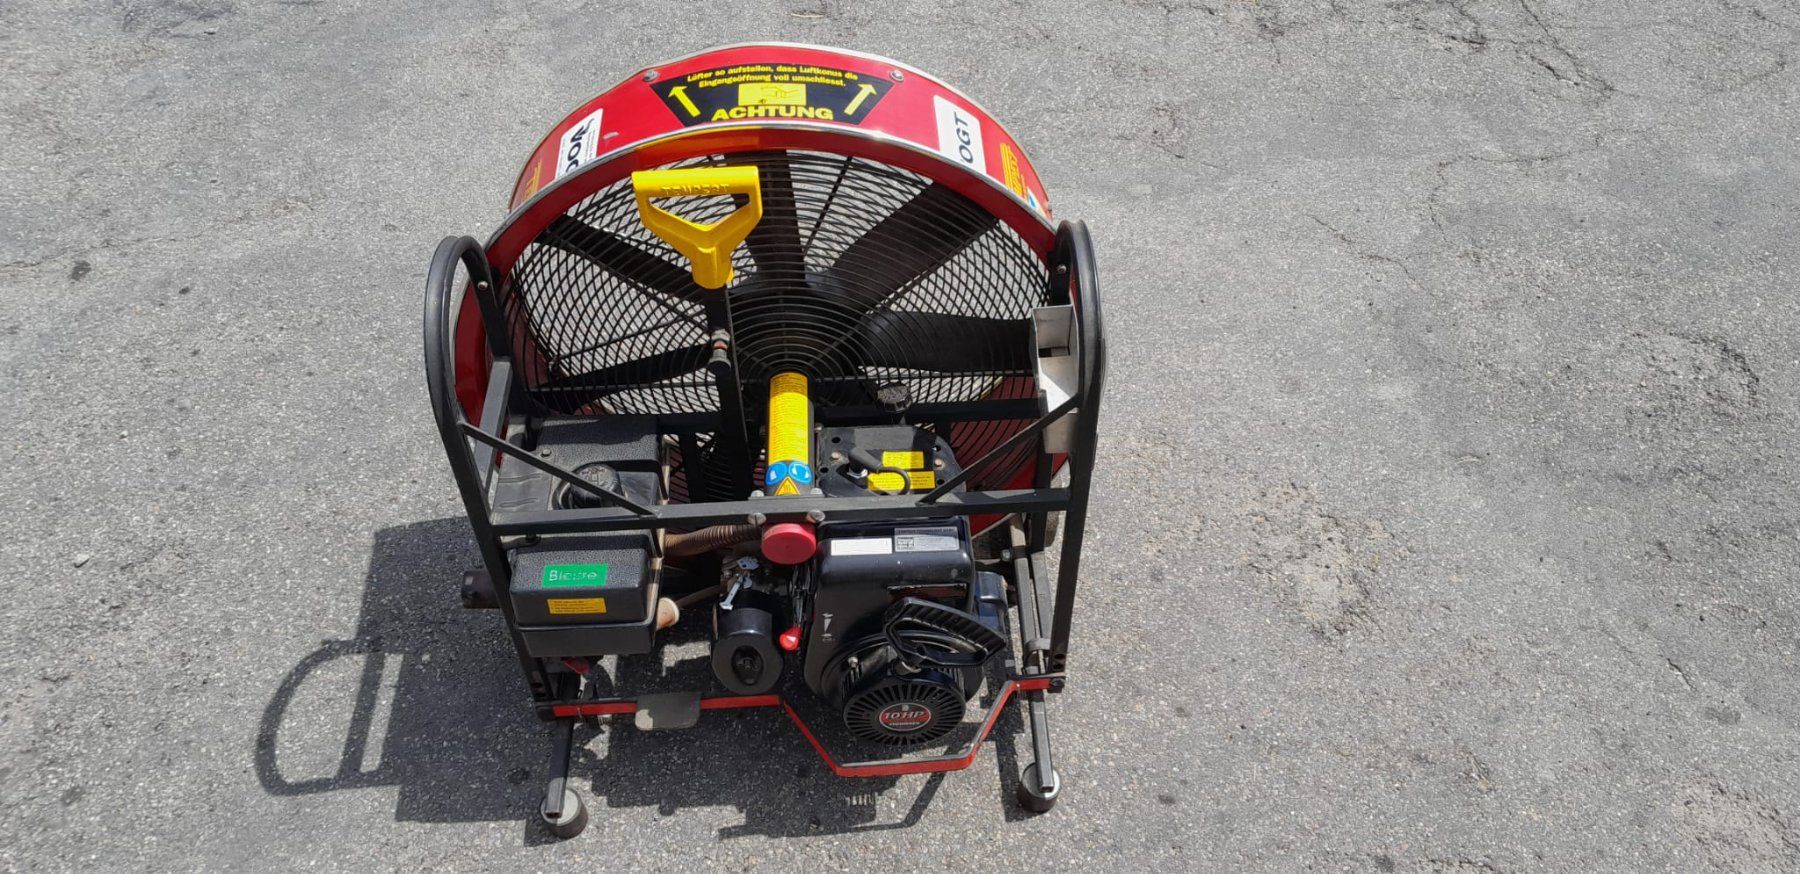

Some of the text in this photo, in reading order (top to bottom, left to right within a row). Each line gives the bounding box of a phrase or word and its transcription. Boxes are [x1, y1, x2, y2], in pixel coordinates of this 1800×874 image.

[687, 65, 859, 83] Lüfter so aufstellen, dass Luftkonus die
[698, 73, 772, 88] Eingangsöffnung
[773, 73, 790, 82] voll
[711, 105, 834, 121] ACHTUNG
[954, 111, 974, 165] OGT
